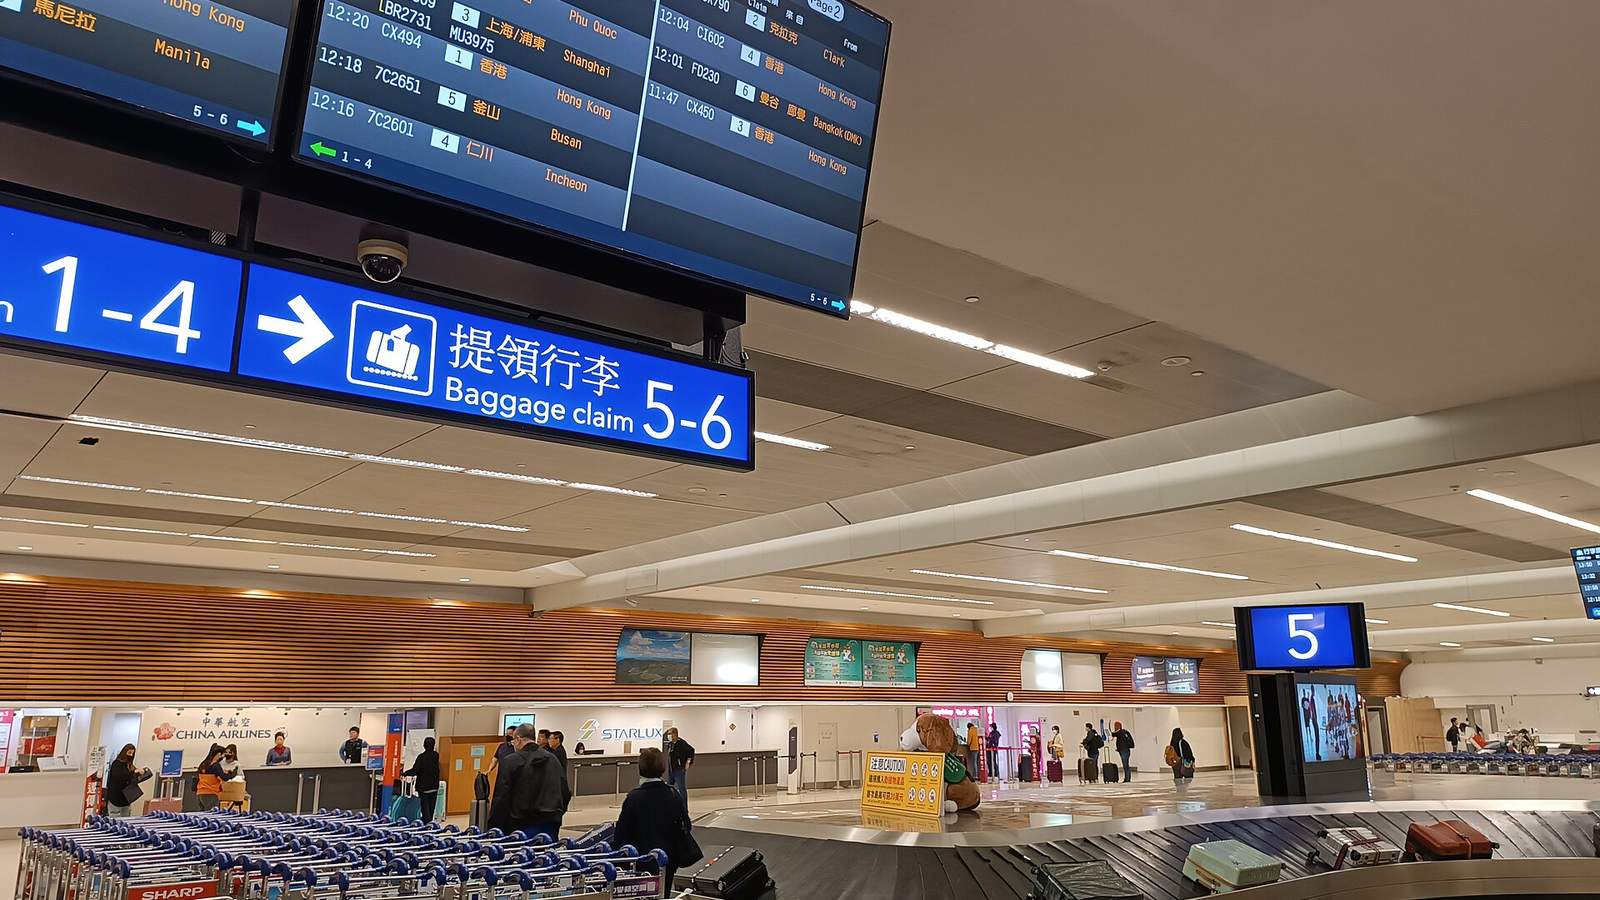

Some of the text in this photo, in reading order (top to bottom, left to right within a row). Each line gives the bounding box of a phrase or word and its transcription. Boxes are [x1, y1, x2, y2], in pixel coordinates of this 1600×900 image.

[33, 0, 96, 32] 馬尼拉
[208, 6, 245, 32] Kong
[326, 2, 422, 49] 12:20 CX494
[461, 8, 470, 22] 3
[569, 9, 617, 40] Phu Quoc
[752, 14, 759, 26] 2
[449, 24, 495, 54] MU3975
[485, 17, 547, 52] 上海/浦東
[659, 9, 725, 49] 12:04 CI602
[769, 21, 799, 45] 克拉克
[154, 38, 210, 70] Manila
[455, 49, 462, 64] 1
[563, 49, 611, 78] Shanghai
[654, 46, 720, 85] 12:01 FD230
[747, 50, 754, 61] 4
[764, 55, 785, 76] 香港
[823, 48, 846, 68] Clark
[319, 47, 421, 95] 12:18 7C2651
[479, 58, 508, 80] 香港
[448, 92, 456, 105] 5
[649, 83, 715, 121] 11:47 CX450
[742, 84, 749, 96] 6
[818, 82, 857, 111] Hong Kong
[311, 91, 414, 137] 12:16 7C2601
[472, 98, 501, 121] 釜山
[556, 88, 611, 120] Hong Kong
[736, 120, 743, 132] 3
[754, 125, 775, 145] 香港
[813, 116, 863, 146] Bangkok(DMK)
[441, 135, 450, 148] 4
[466, 140, 494, 162] 仁川
[550, 128, 582, 150] Busan
[808, 150, 847, 175] Hong Kong
[544, 168, 588, 193] Incheon
[41, 255, 201, 354] 1-4
[448, 322, 621, 398] 提領行李
[445, 375, 634, 434] Baggage claim
[643, 379, 733, 450] 5-6
[1287, 613, 1319, 660] 5
[176, 729, 271, 740] CHINA AIRLINES
[202, 717, 251, 728] 中華航空
[602, 728, 663, 740] STARLUX
[142, 886, 204, 900] SHARP
